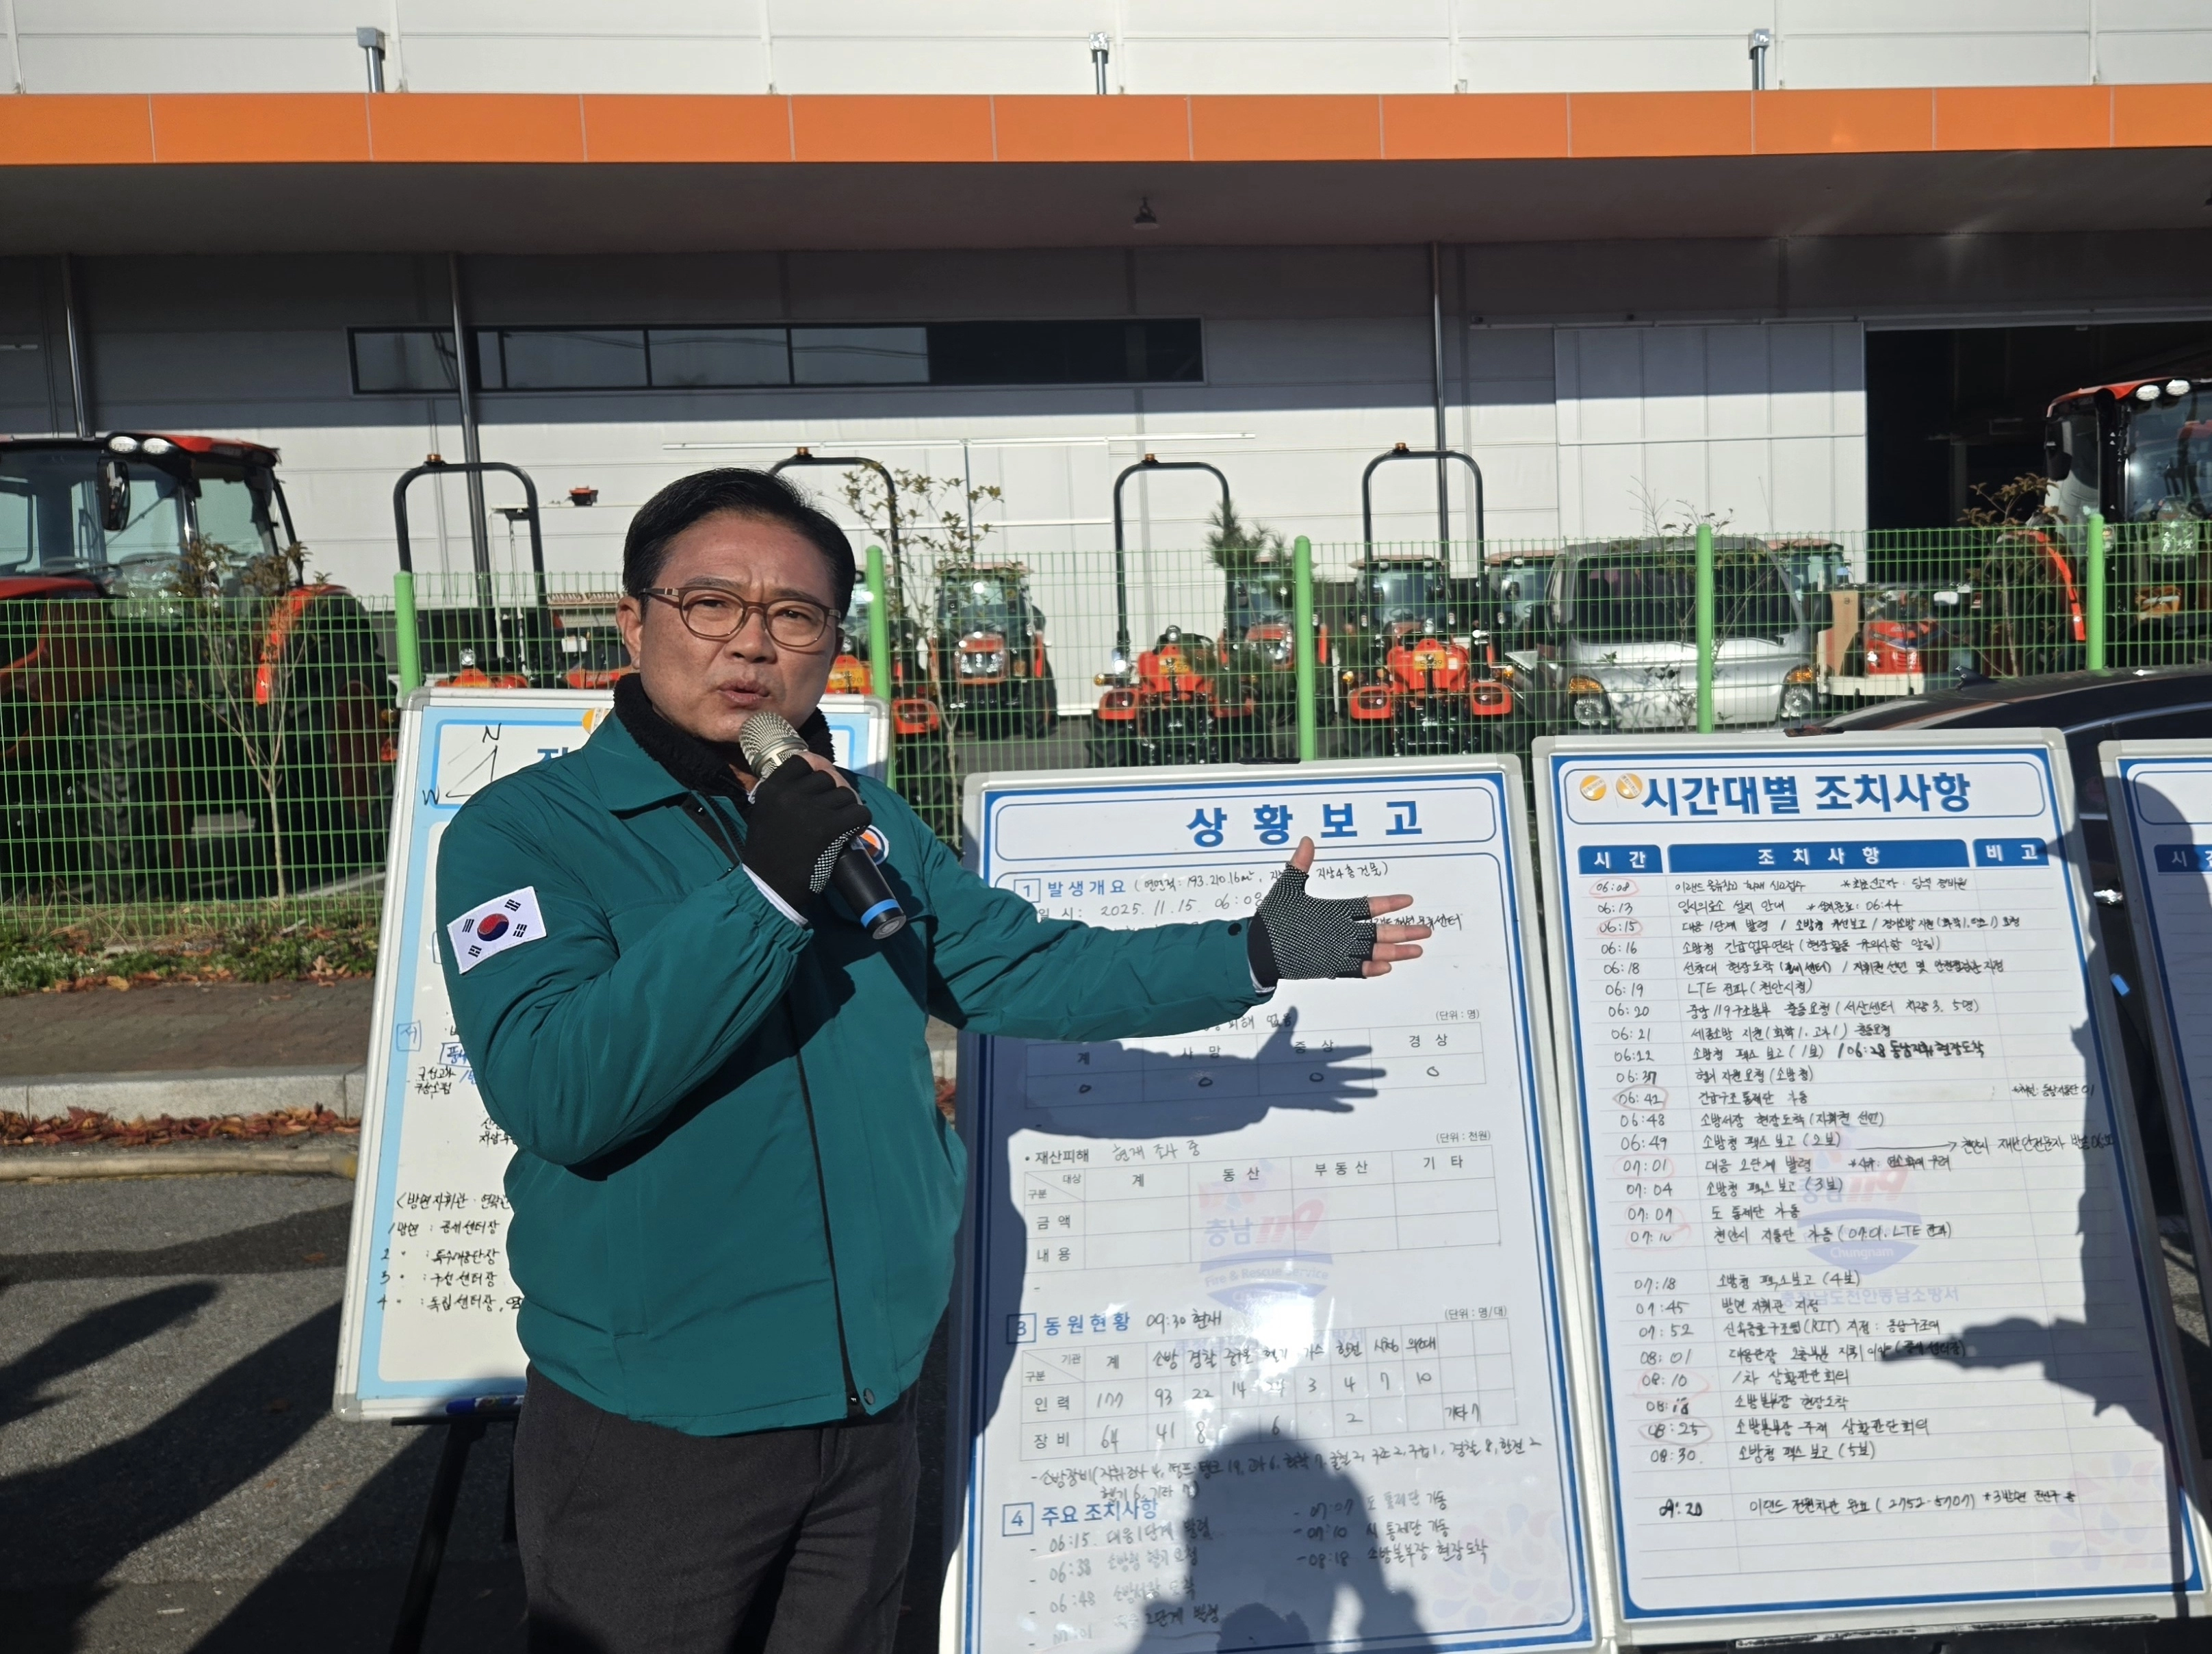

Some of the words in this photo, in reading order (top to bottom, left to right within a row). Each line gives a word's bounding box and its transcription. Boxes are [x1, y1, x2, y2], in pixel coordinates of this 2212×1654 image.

[483, 723, 501, 743] N
[422, 785, 439, 806] W
[1641, 776, 1801, 816] 시간대별
[1815, 772, 1971, 813] 조치사항
[1048, 879, 1127, 898] 발생개요
[1596, 882, 1630, 893] 06:08
[1597, 902, 1633, 915] 06:13
[1761, 899, 1786, 913] 안내
[1599, 920, 1638, 933] 06:15
[1602, 942, 1638, 954] 06:16
[1604, 962, 1641, 974] 06:18
[1605, 983, 1644, 997] 06:19
[1688, 982, 1716, 997] LTE
[1608, 1004, 1650, 1018] 06:20
[1611, 1027, 1651, 1042] 06:21
[1077, 1052, 1090, 1065] 계
[1620, 1113, 1664, 1128] 06:48
[1701, 1112, 1745, 1128] 소방서장
[1754, 1112, 1805, 1128] 현장도착
[1621, 1136, 1667, 1151] 06:49
[1702, 1134, 1737, 1150] 소방청
[1775, 1133, 1796, 1147] 보고
[1035, 1148, 1090, 1165] 재산피해
[1063, 1173, 1081, 1184] 대상
[1132, 1173, 1145, 1186] 계
[1028, 1188, 1047, 1199] 구분
[1829, 1246, 1894, 1261] Chungnam
[1044, 1312, 1131, 1336] 동원현황
[1061, 1354, 1081, 1366] 기관
[1106, 1355, 1120, 1369] 계
[1640, 1349, 1692, 1365] 08:01
[1025, 1371, 1046, 1382] 구분
[1643, 1372, 1688, 1387] 08:10
[1155, 1388, 1173, 1406] 93
[1308, 1378, 1317, 1392] 3
[1271, 1416, 1281, 1436] 6
[1012, 1510, 1024, 1527] 4
[1041, 1505, 1078, 1526] 주요
[1085, 1497, 1159, 1521] 조치사항
